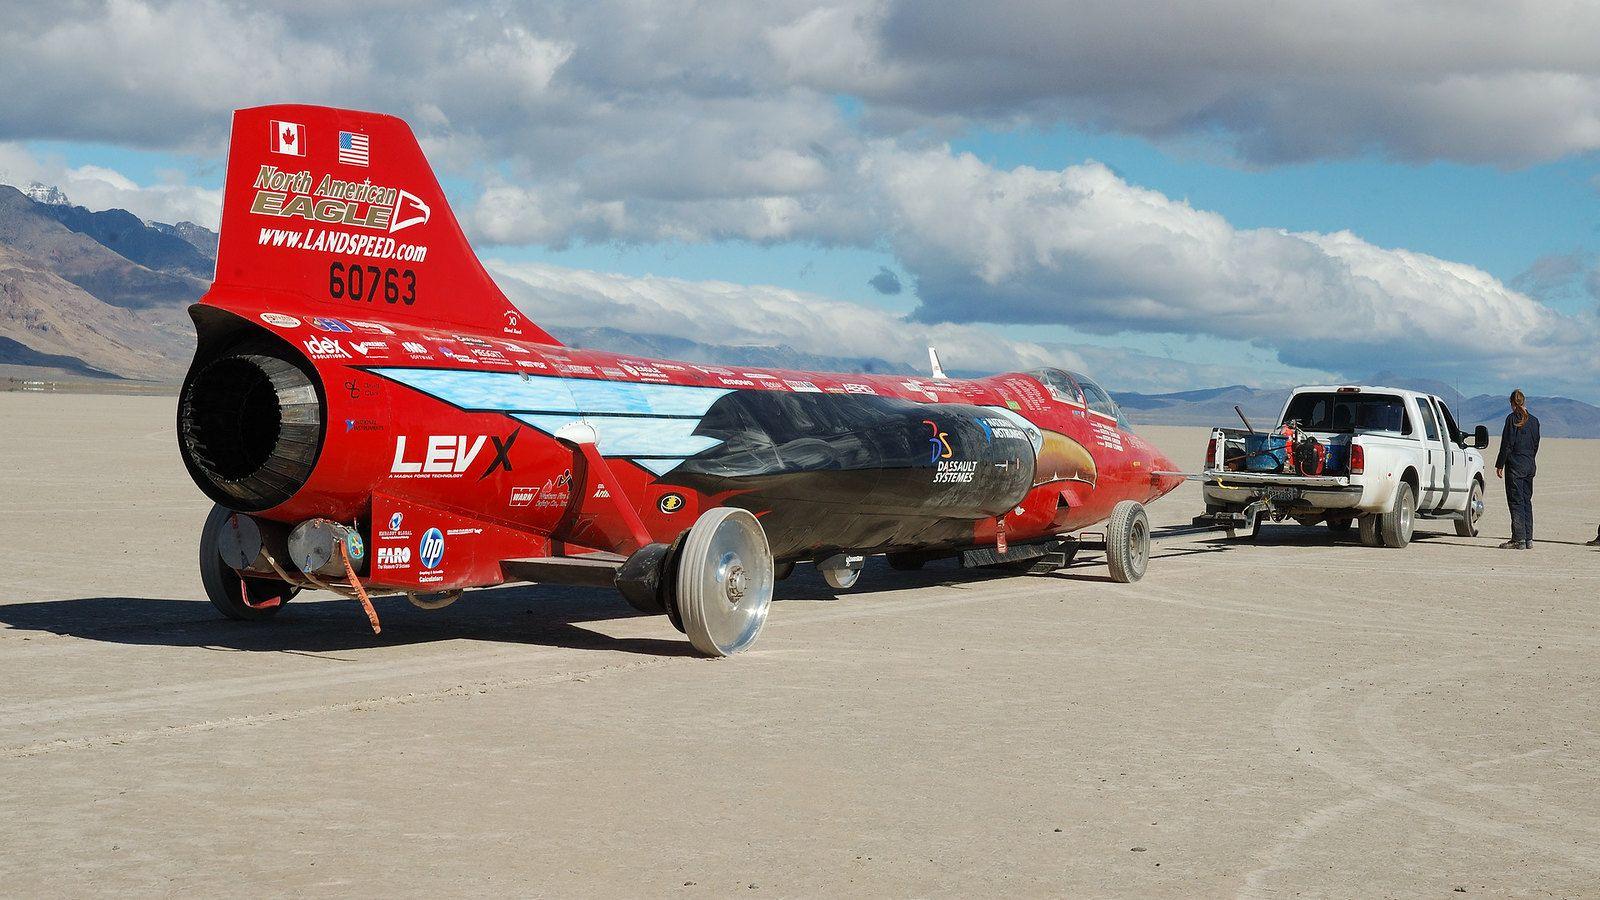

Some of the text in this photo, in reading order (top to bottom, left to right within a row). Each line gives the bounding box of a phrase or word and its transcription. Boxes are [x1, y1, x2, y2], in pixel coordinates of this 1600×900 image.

[253, 165, 396, 206] North American
[250, 190, 392, 230] EAGLE
[258, 228, 428, 263] www.LANDSPEED.com
[329, 261, 416, 305] 60763
[933, 472, 974, 483] SYSTEMES
[937, 461, 978, 472] DASSAULT
[513, 493, 534, 501] WARN
[377, 546, 411, 564] FARO
